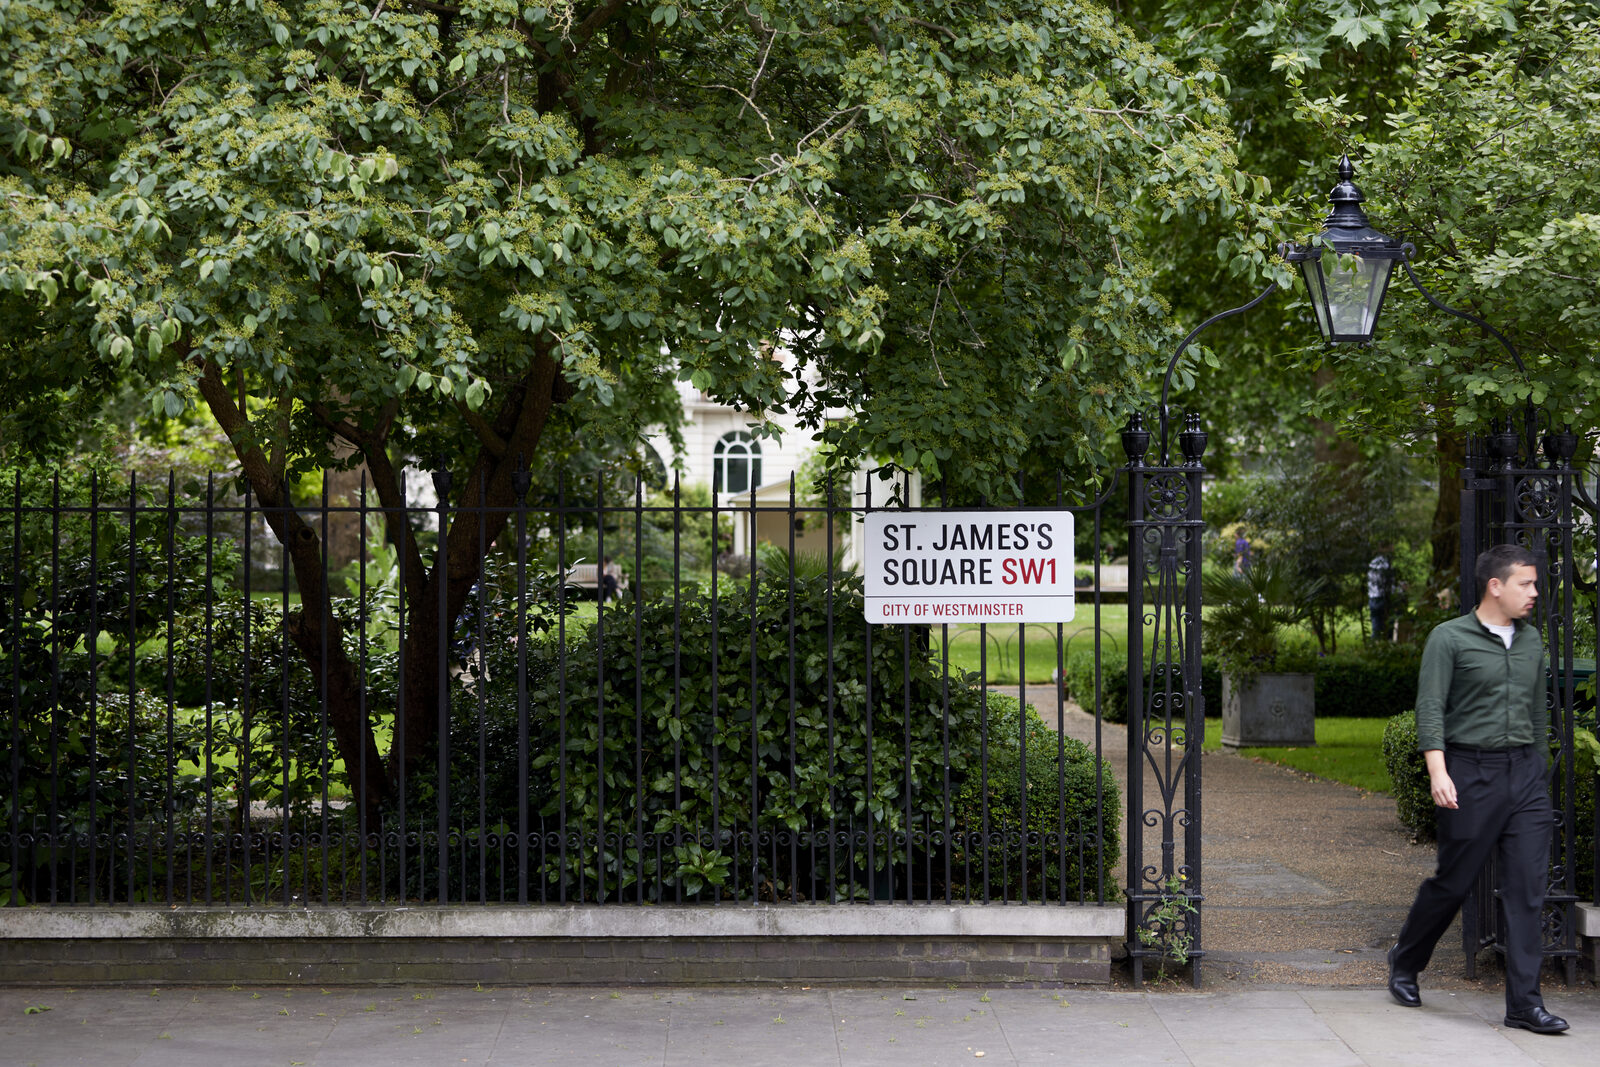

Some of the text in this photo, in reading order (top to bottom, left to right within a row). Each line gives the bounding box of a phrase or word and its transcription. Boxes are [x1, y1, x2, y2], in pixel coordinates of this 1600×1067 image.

[883, 523, 1053, 551] ST. JAMES'S
[883, 558, 1056, 585] SQUARE SW1
[882, 603, 1024, 617] CITY OF WESTMINSTER
